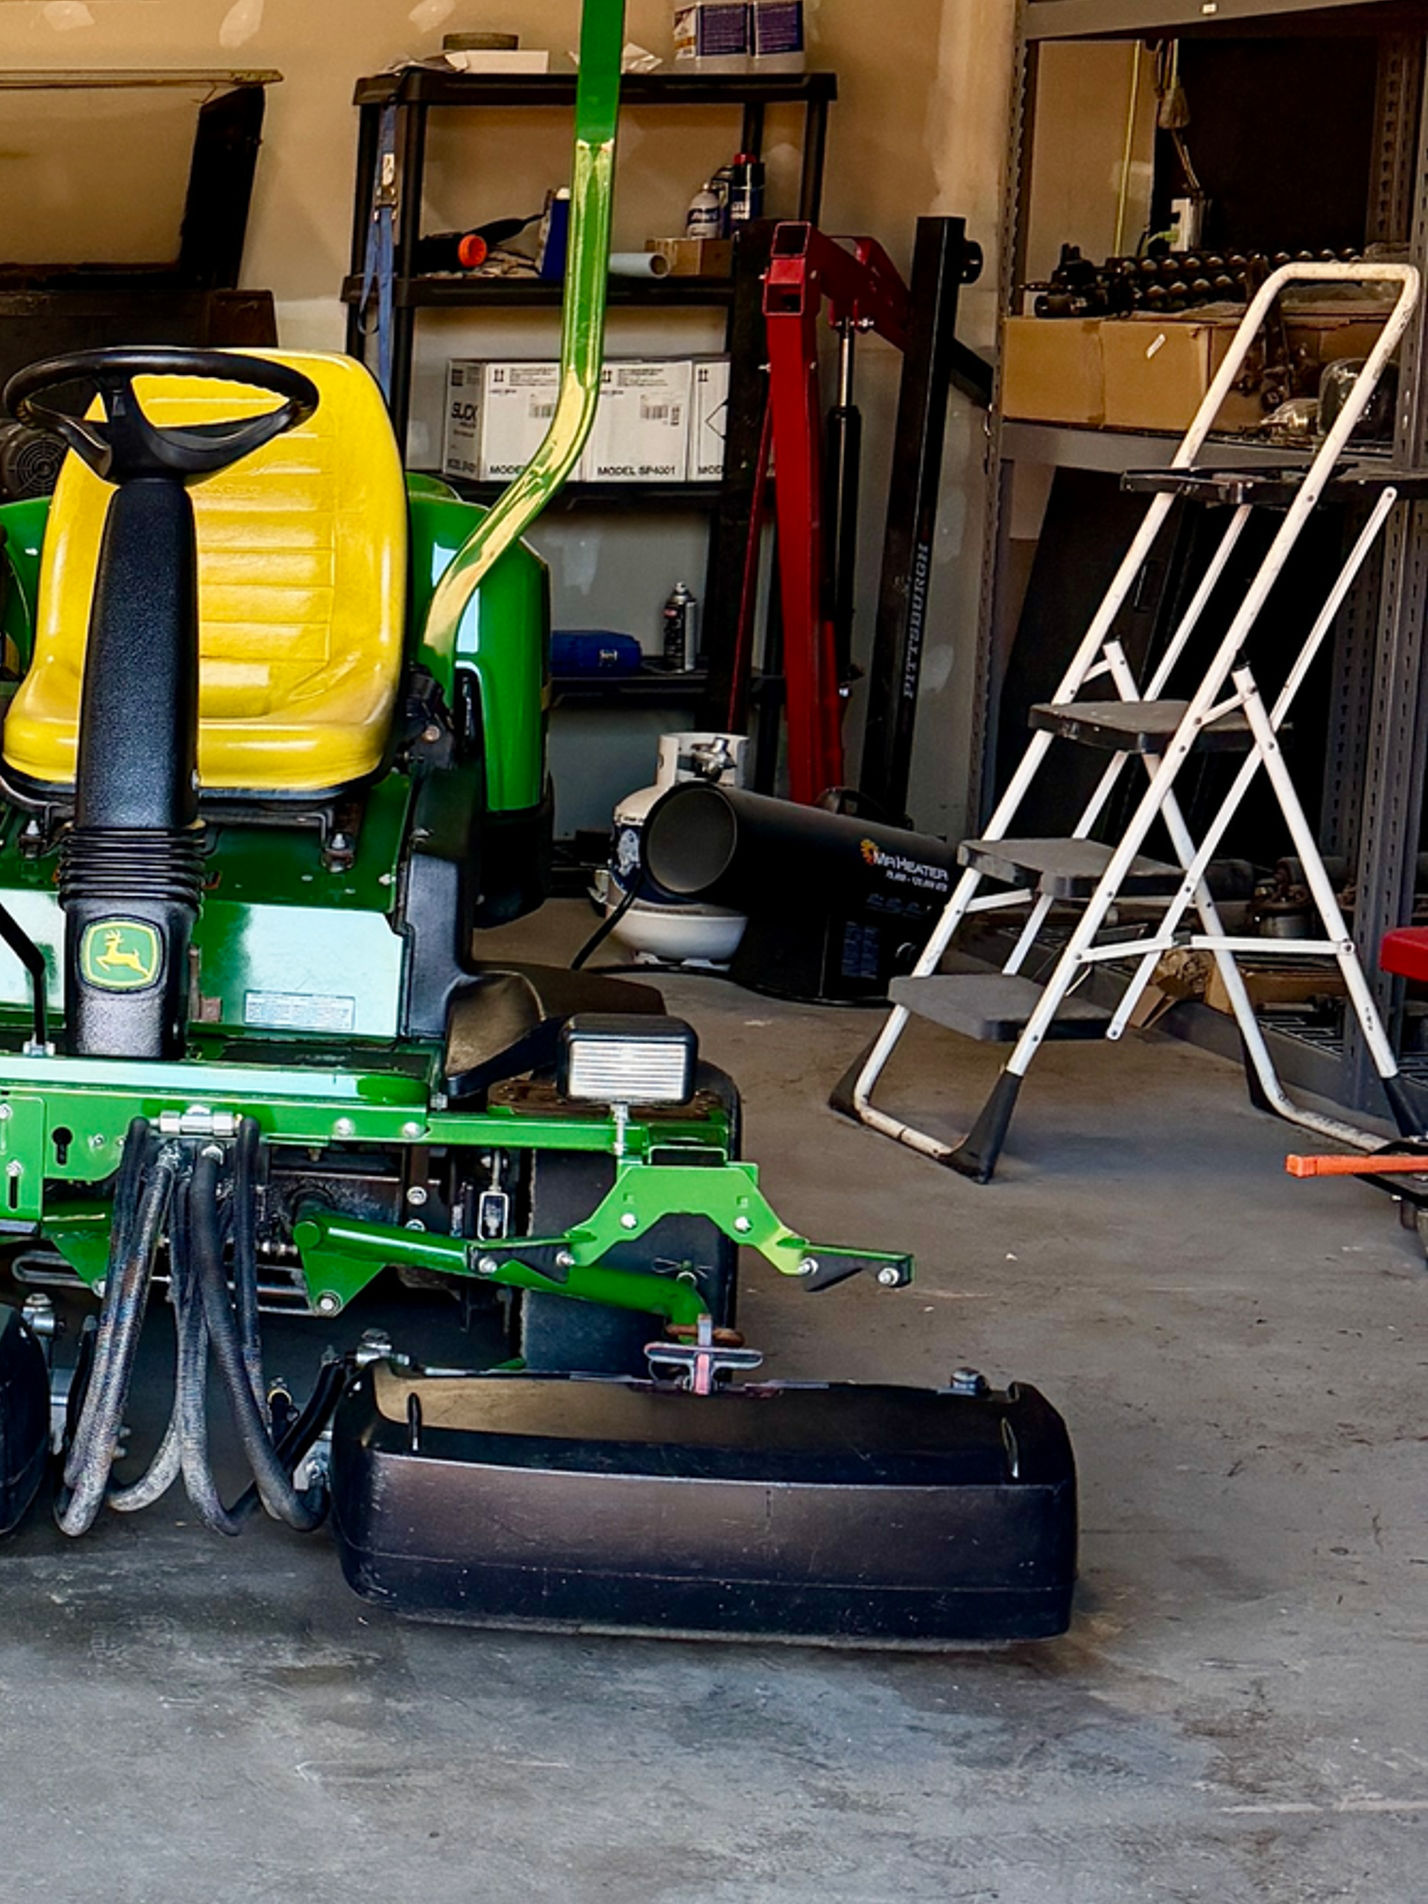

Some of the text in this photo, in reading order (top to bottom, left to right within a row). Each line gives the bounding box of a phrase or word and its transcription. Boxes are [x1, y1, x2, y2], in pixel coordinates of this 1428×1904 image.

[597, 465, 635, 476] MODEL
[698, 464, 724, 475] MOD
[903, 542, 929, 699] PITTSBURGH
